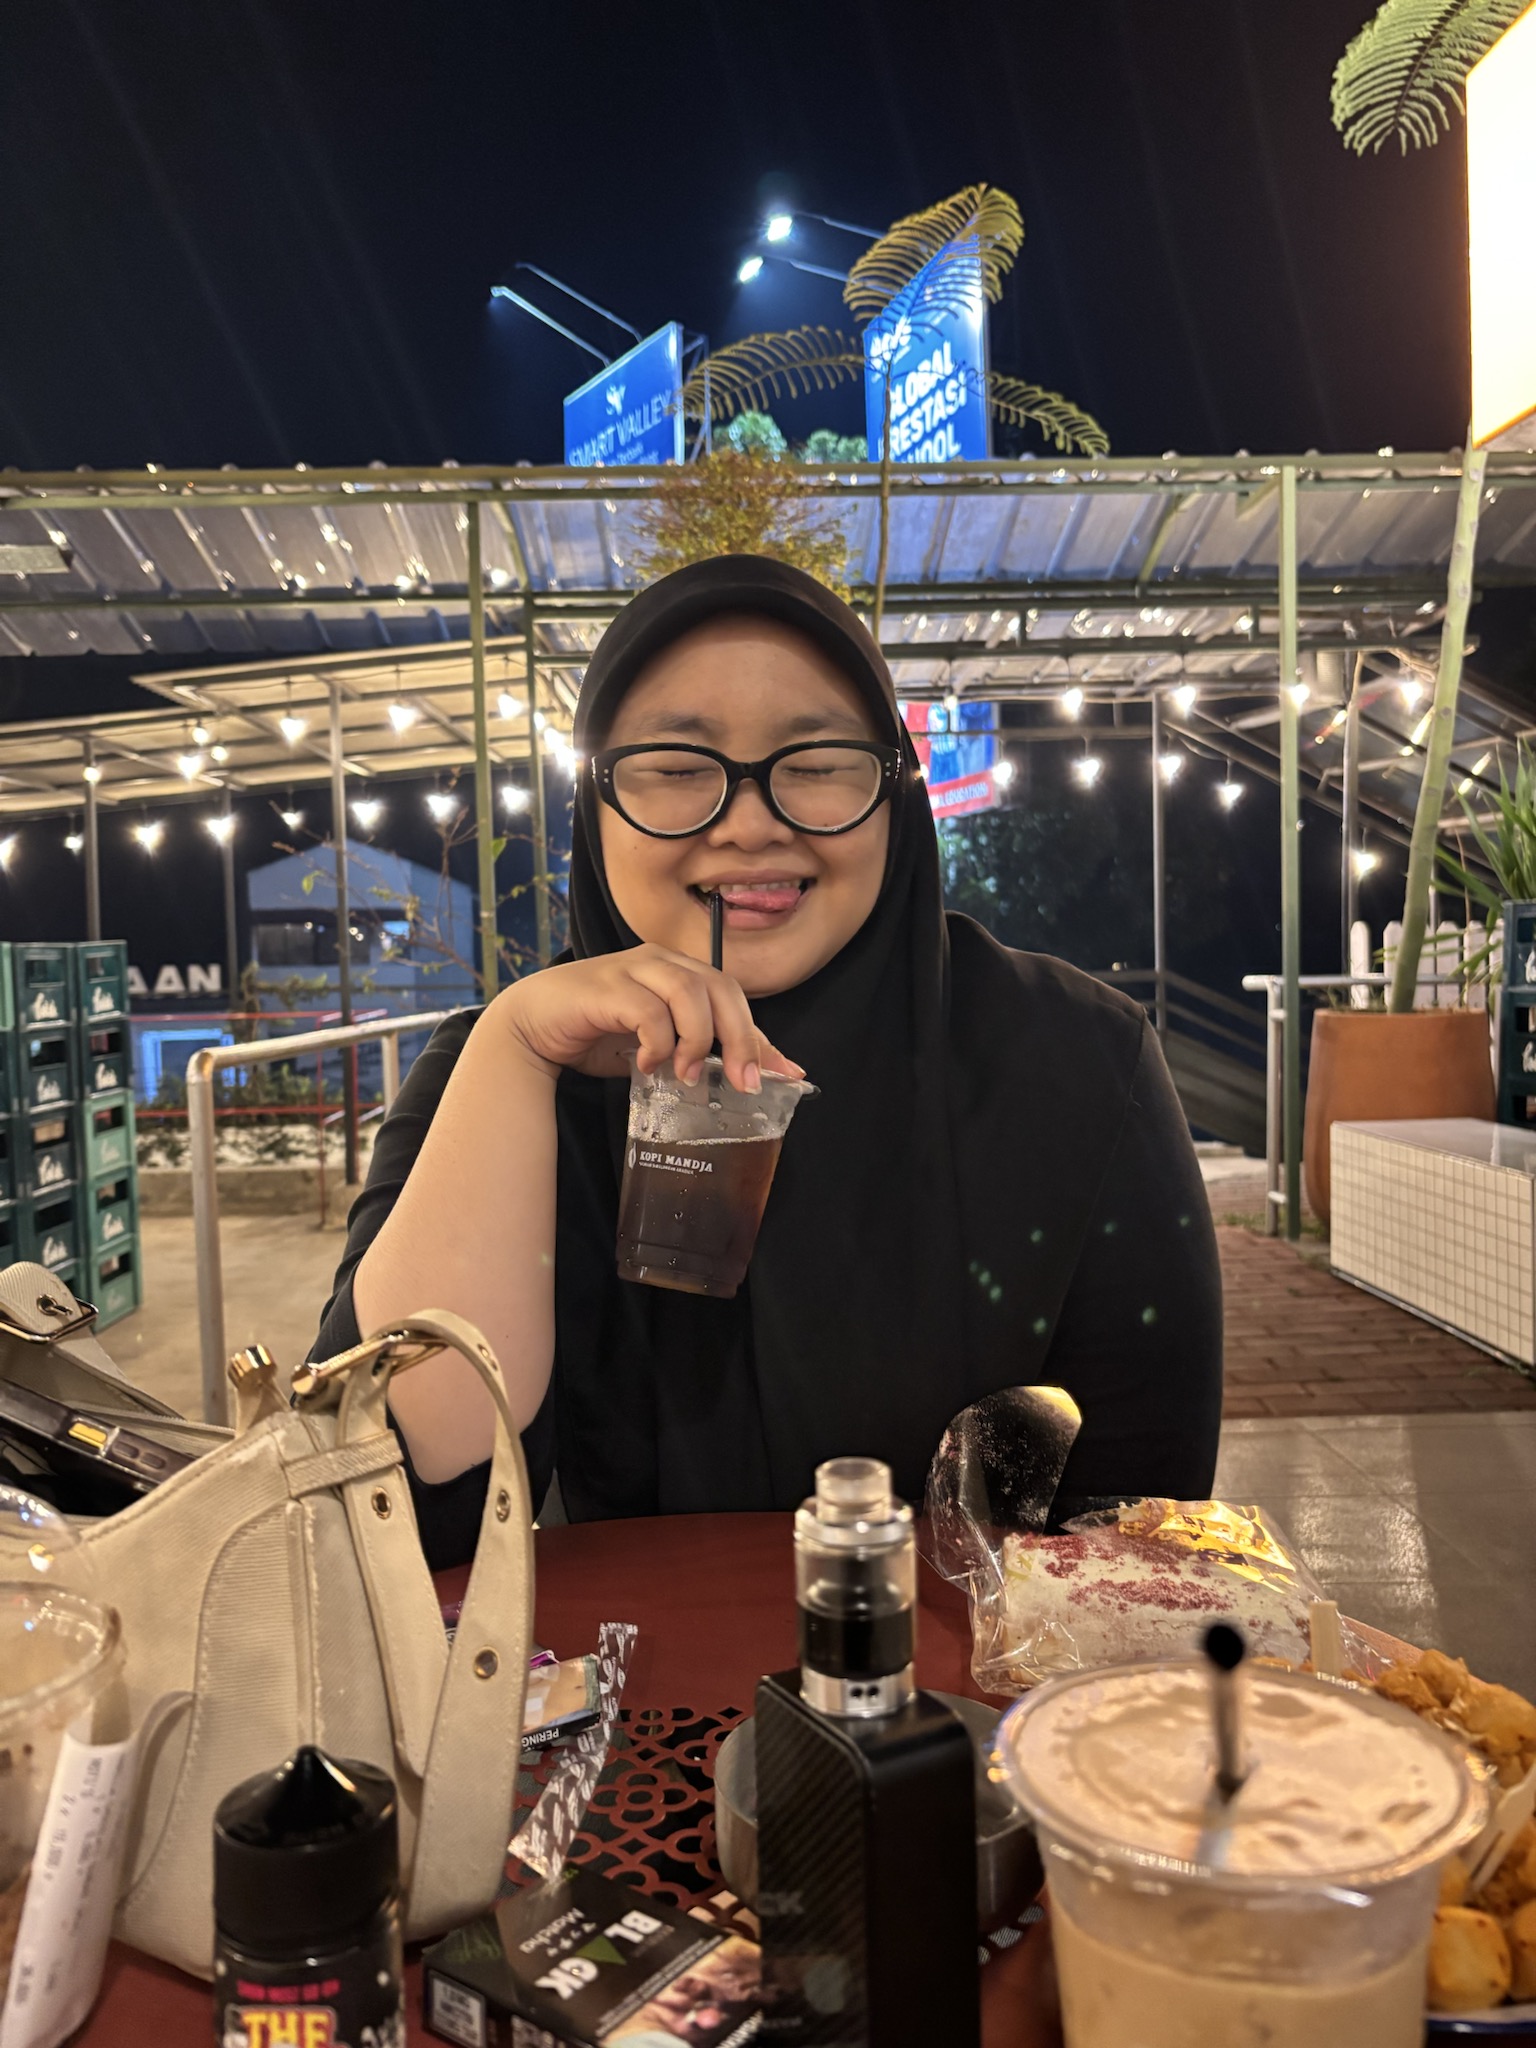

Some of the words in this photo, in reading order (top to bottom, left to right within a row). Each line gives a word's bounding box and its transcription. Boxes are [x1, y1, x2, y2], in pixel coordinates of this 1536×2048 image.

[639, 1150, 662, 1164] KOPI
[665, 1154, 713, 1173] MANDJA
[521, 1728, 560, 1748] PERING
[519, 1907, 585, 1954] Matcha
[241, 2010, 330, 2048] THE
